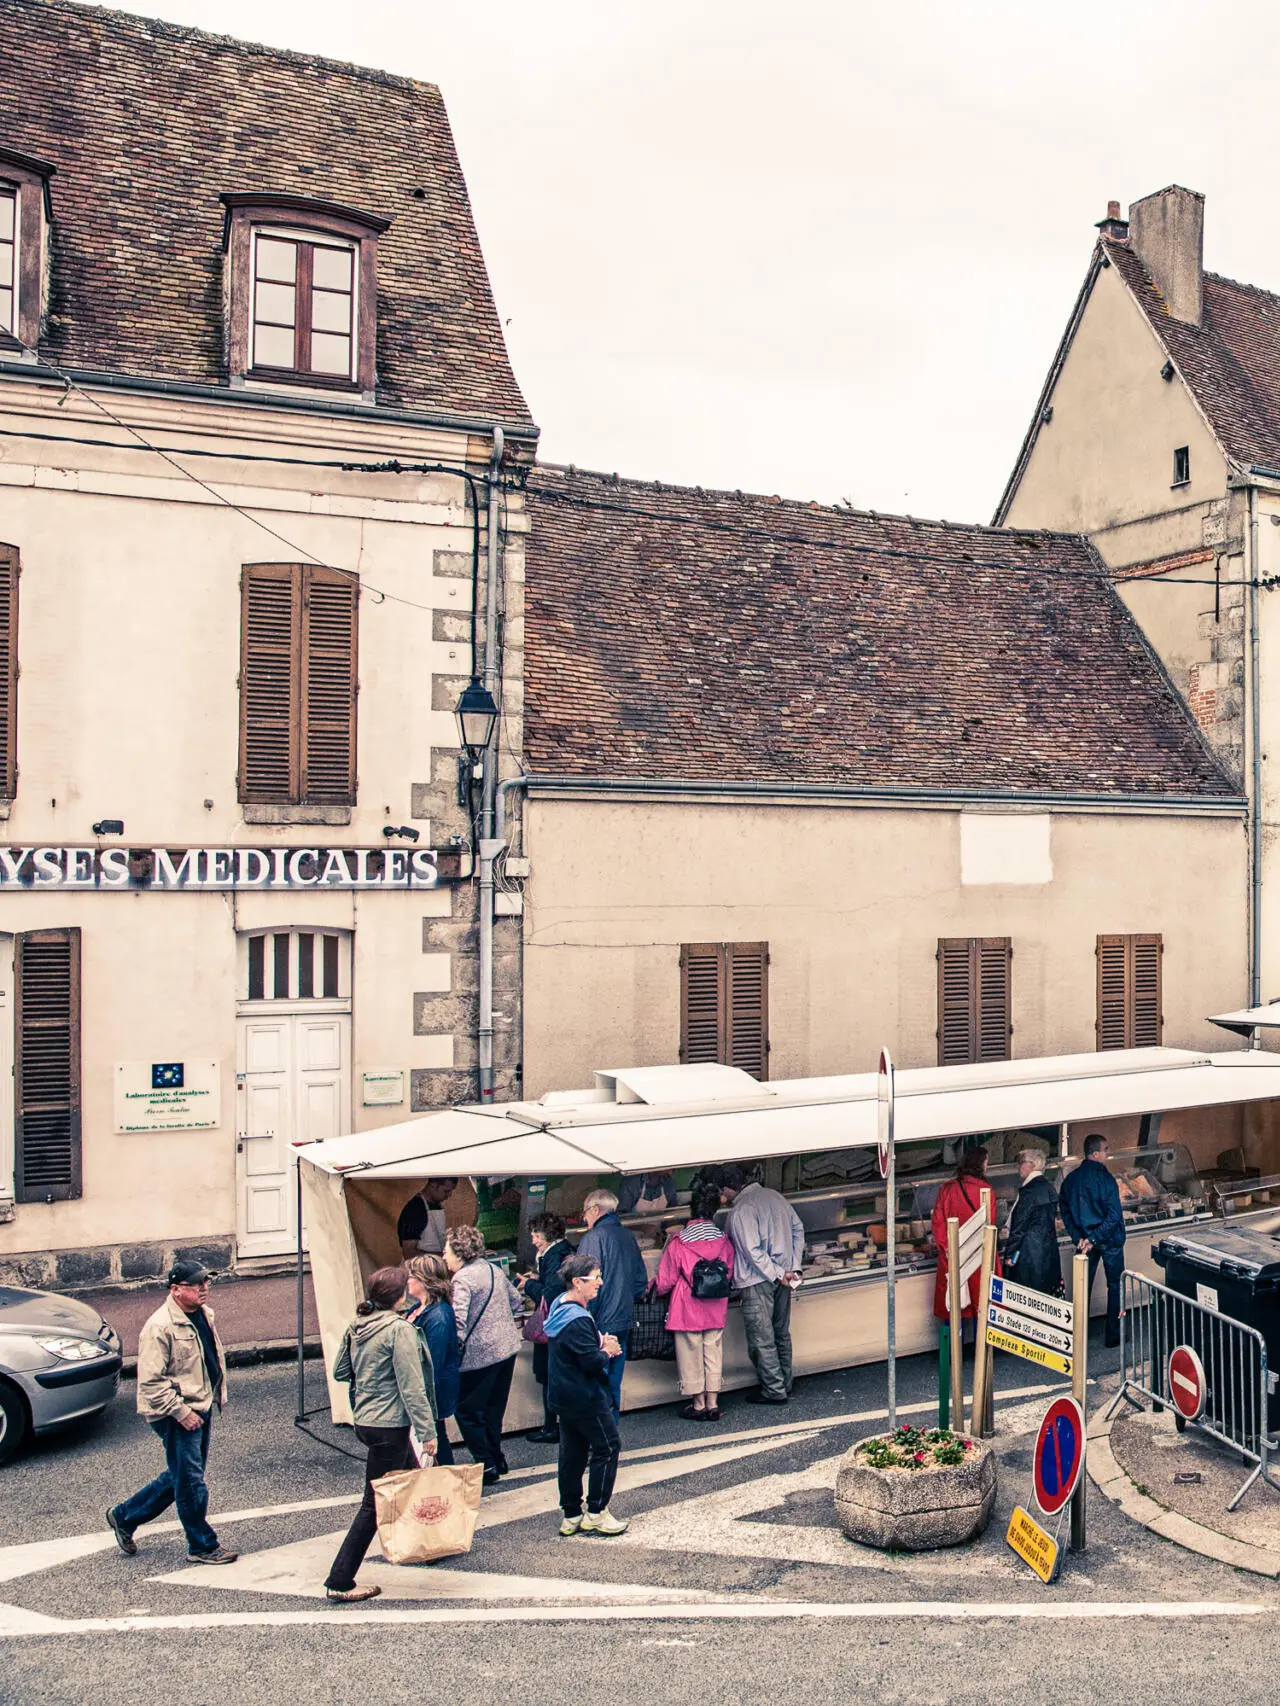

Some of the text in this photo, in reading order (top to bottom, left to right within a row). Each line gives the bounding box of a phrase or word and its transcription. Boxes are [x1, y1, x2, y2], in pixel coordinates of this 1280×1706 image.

[0, 847, 438, 885] YSES MEDICALES
[1006, 1289, 1027, 1306] TOUTES
[1027, 1297, 1062, 1319] DIRECTIONS
[997, 1314, 1005, 1323] du
[1006, 1316, 1022, 1330] Stade
[988, 1331, 1046, 1362] Complexe Sportif
